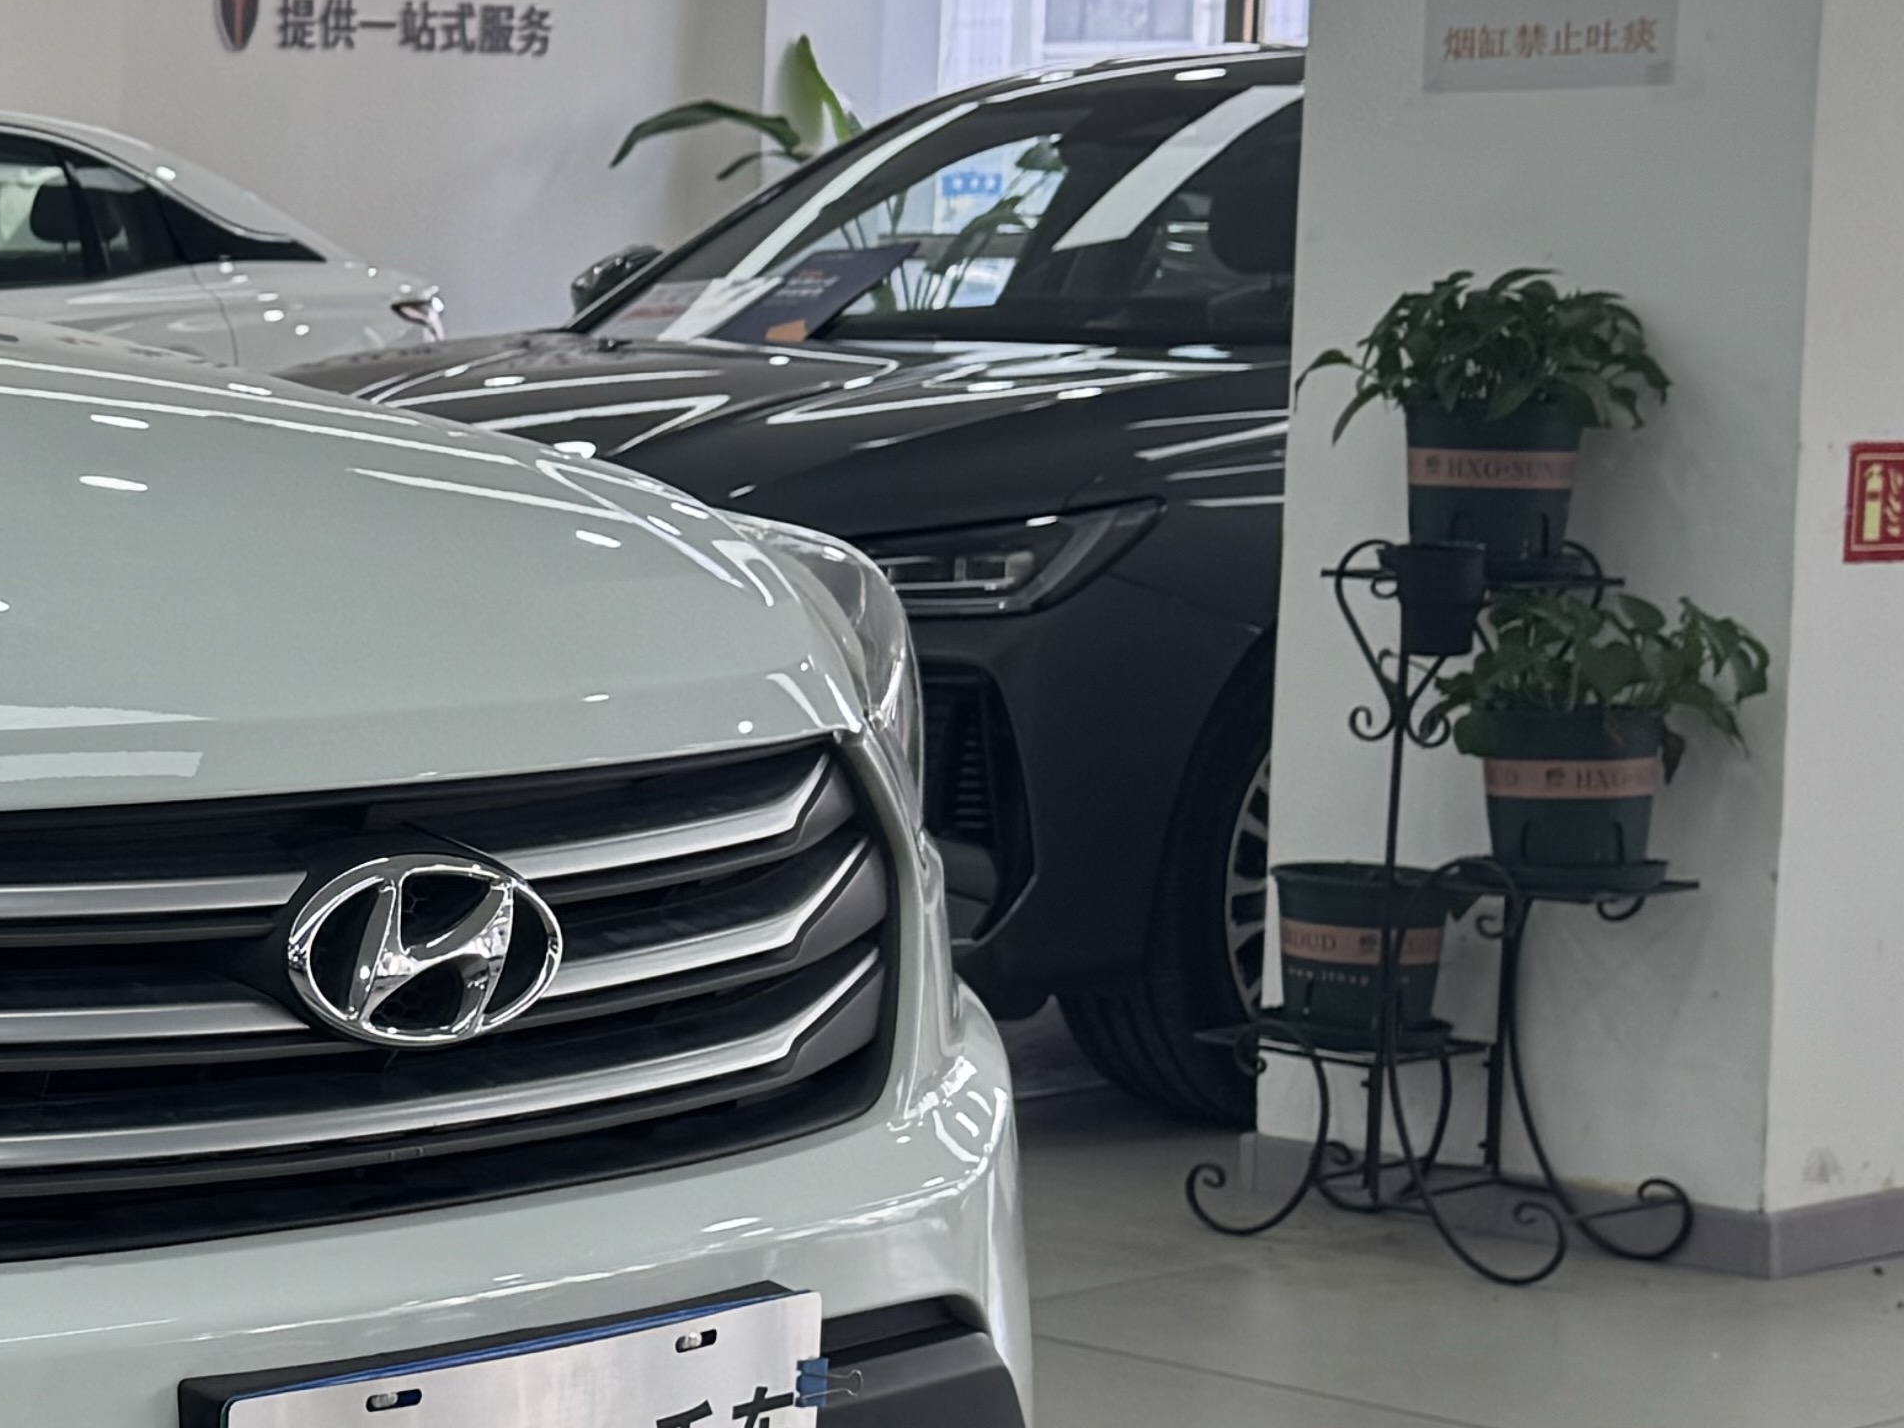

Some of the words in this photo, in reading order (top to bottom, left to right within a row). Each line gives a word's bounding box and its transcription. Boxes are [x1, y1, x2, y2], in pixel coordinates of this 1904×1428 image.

[1443, 18, 1657, 61] 烟缸禁止吐痰
